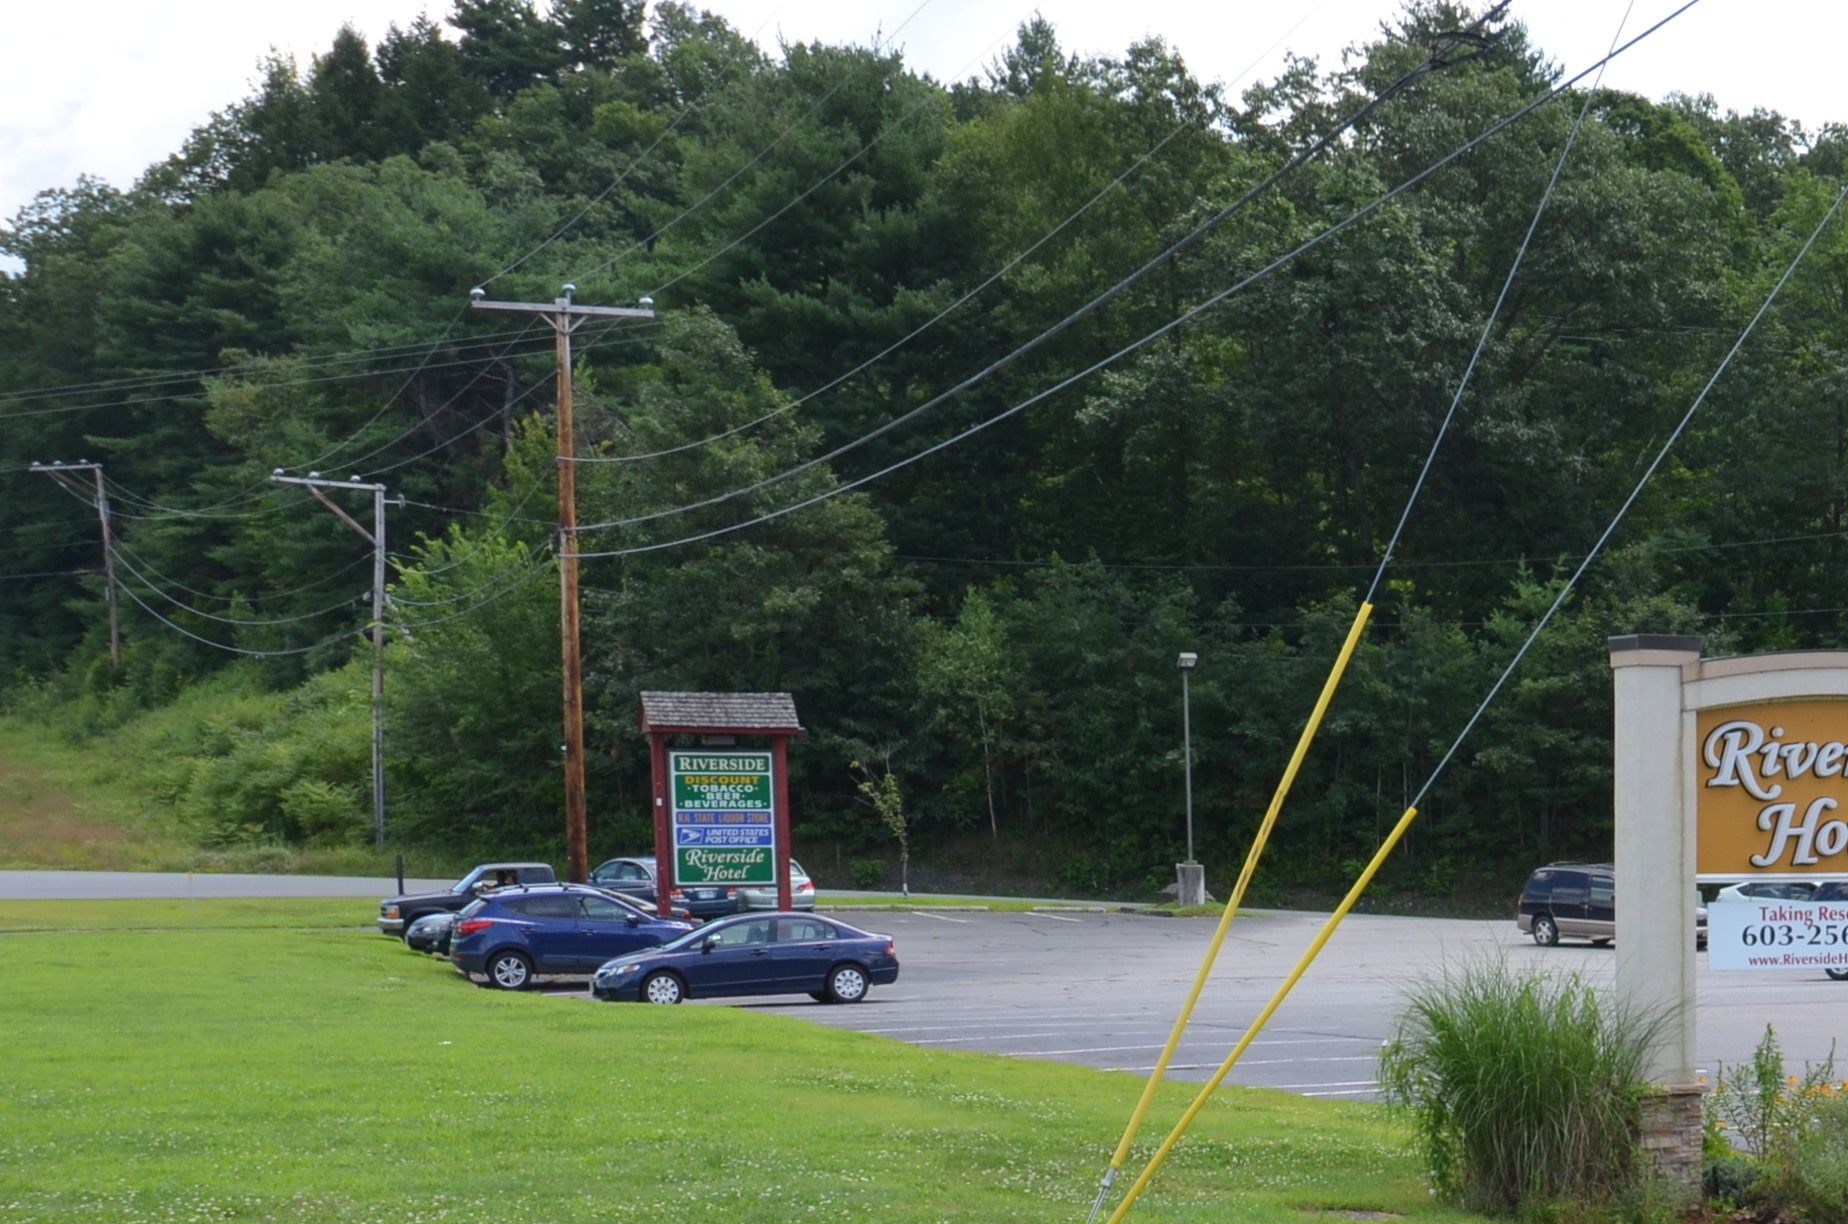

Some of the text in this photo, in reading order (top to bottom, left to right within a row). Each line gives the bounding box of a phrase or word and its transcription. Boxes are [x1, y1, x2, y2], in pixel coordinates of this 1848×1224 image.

[679, 757, 766, 770] RIVERSIDE
[685, 775, 759, 784] DISCOUNT
[692, 784, 754, 792] TOBACCO
[706, 792, 740, 800] BEER
[684, 800, 762, 808] BEVERAGES
[695, 813, 714, 823] STATE
[719, 813, 744, 823] LIQUOR
[747, 813, 769, 823] STORE
[705, 836, 758, 844] POST OFFICE
[685, 848, 764, 869] Riverside
[703, 865, 749, 881] Hotel
[1760, 907, 1812, 926] Taking
